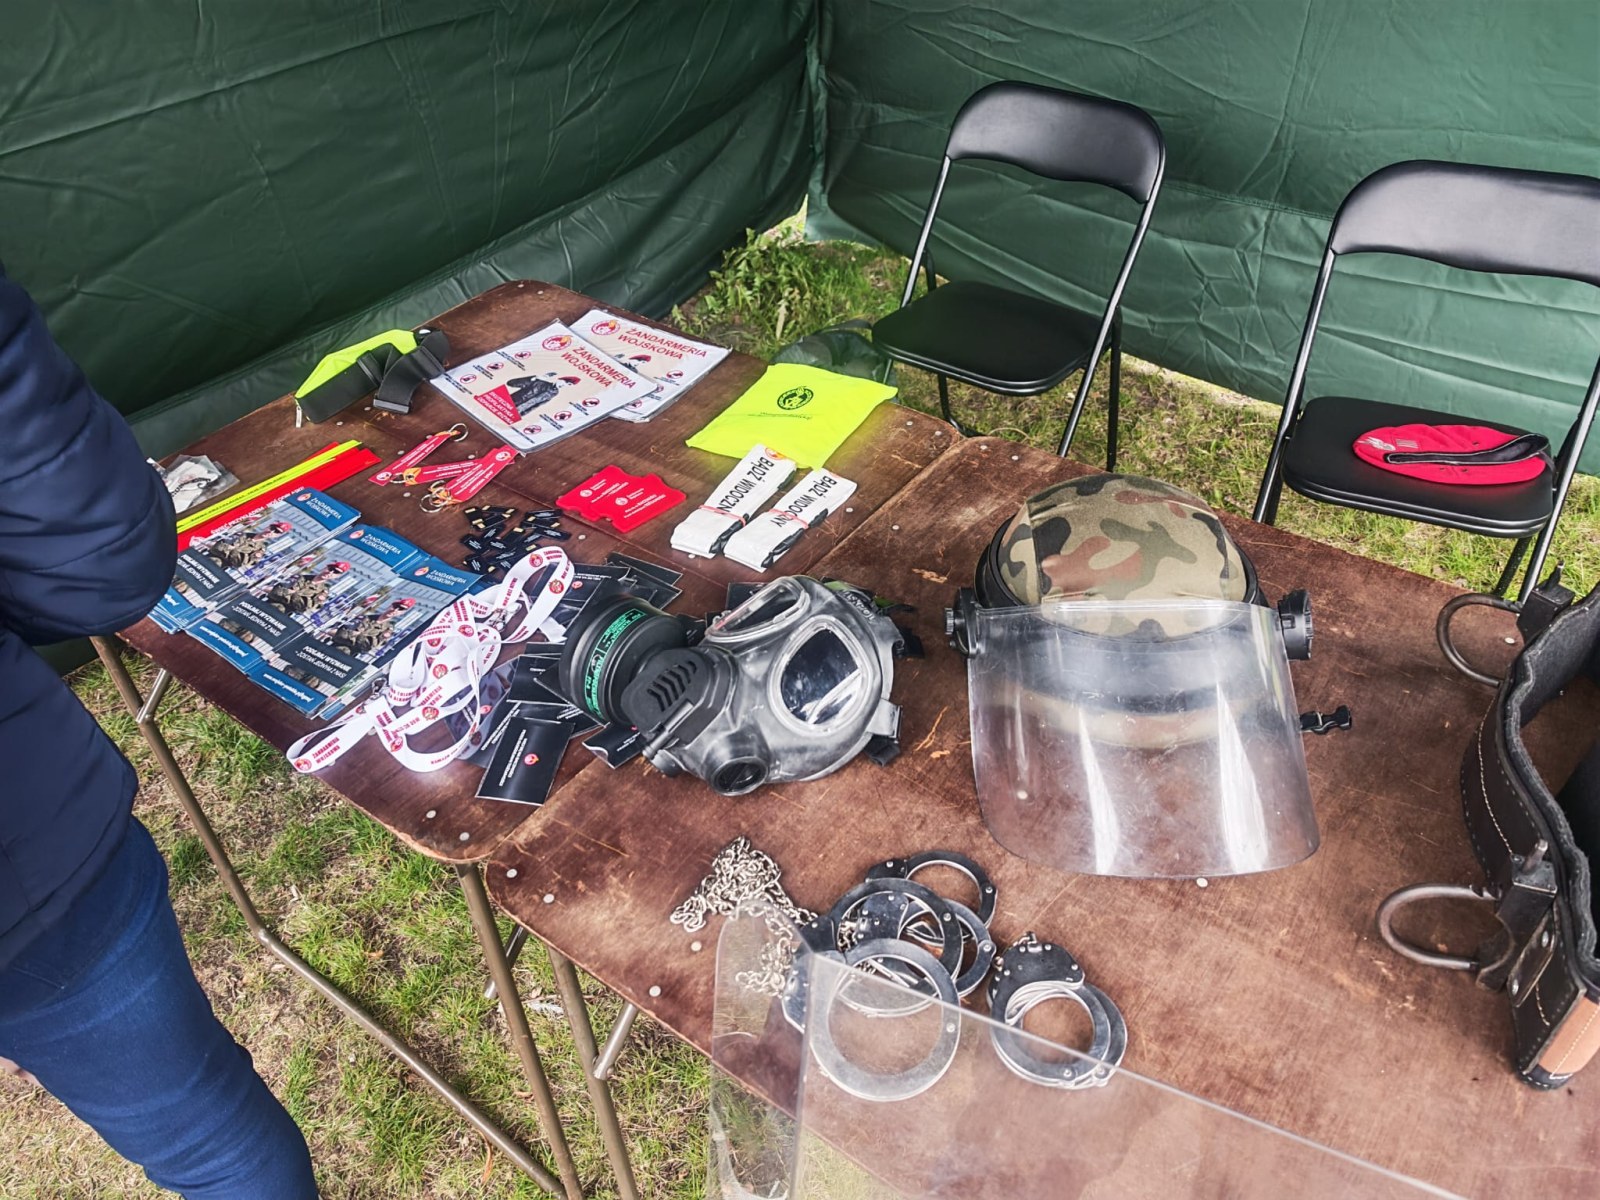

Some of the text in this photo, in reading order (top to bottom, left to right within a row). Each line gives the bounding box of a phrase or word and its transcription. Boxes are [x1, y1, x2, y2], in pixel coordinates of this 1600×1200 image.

[617, 334, 684, 360] WOJSKOWA
[625, 327, 707, 358] ŻANDARMERIA
[560, 352, 612, 388] WOJSKOWA
[572, 346, 636, 389] ŻANDARMERIA
